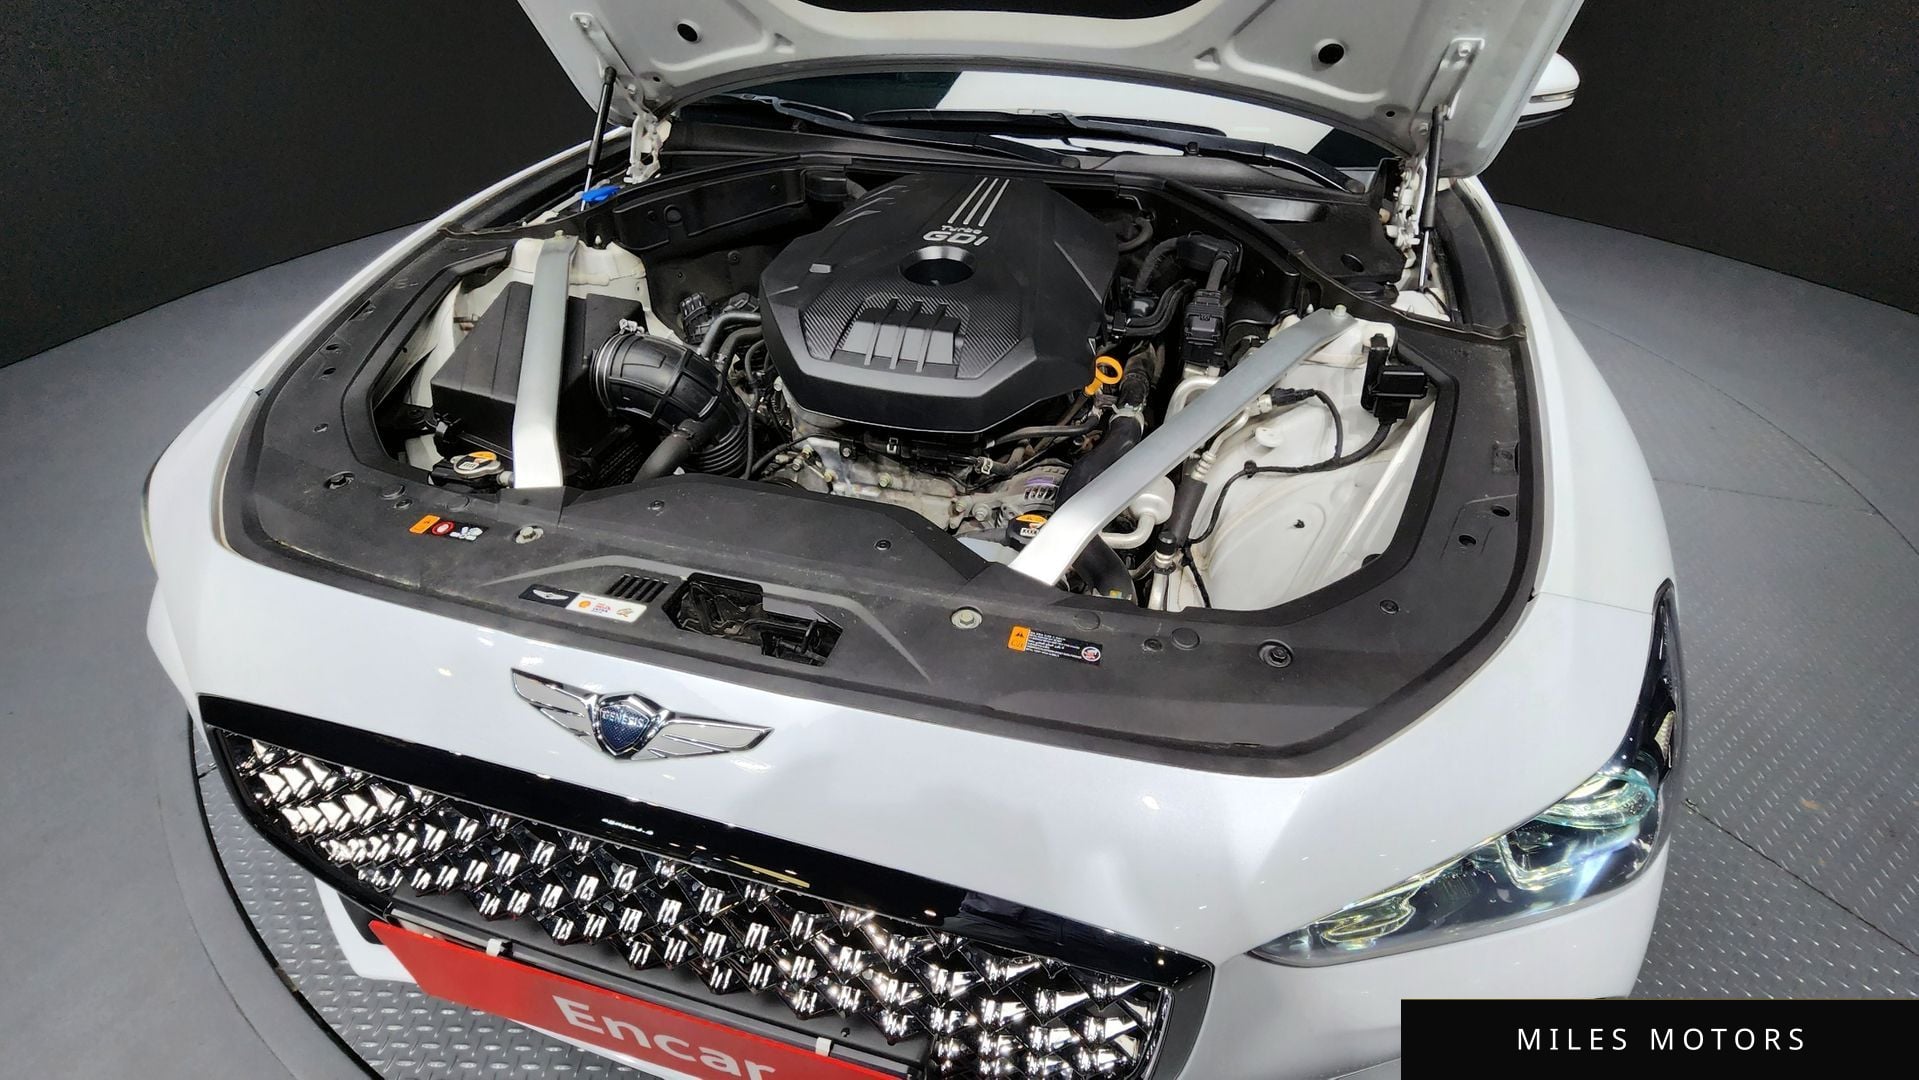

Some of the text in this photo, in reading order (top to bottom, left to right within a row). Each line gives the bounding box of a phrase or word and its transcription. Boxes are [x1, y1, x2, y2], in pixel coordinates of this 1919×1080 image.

[923, 230, 989, 246] GDI
[941, 225, 982, 235] Turbo
[552, 994, 776, 1080] Encar
